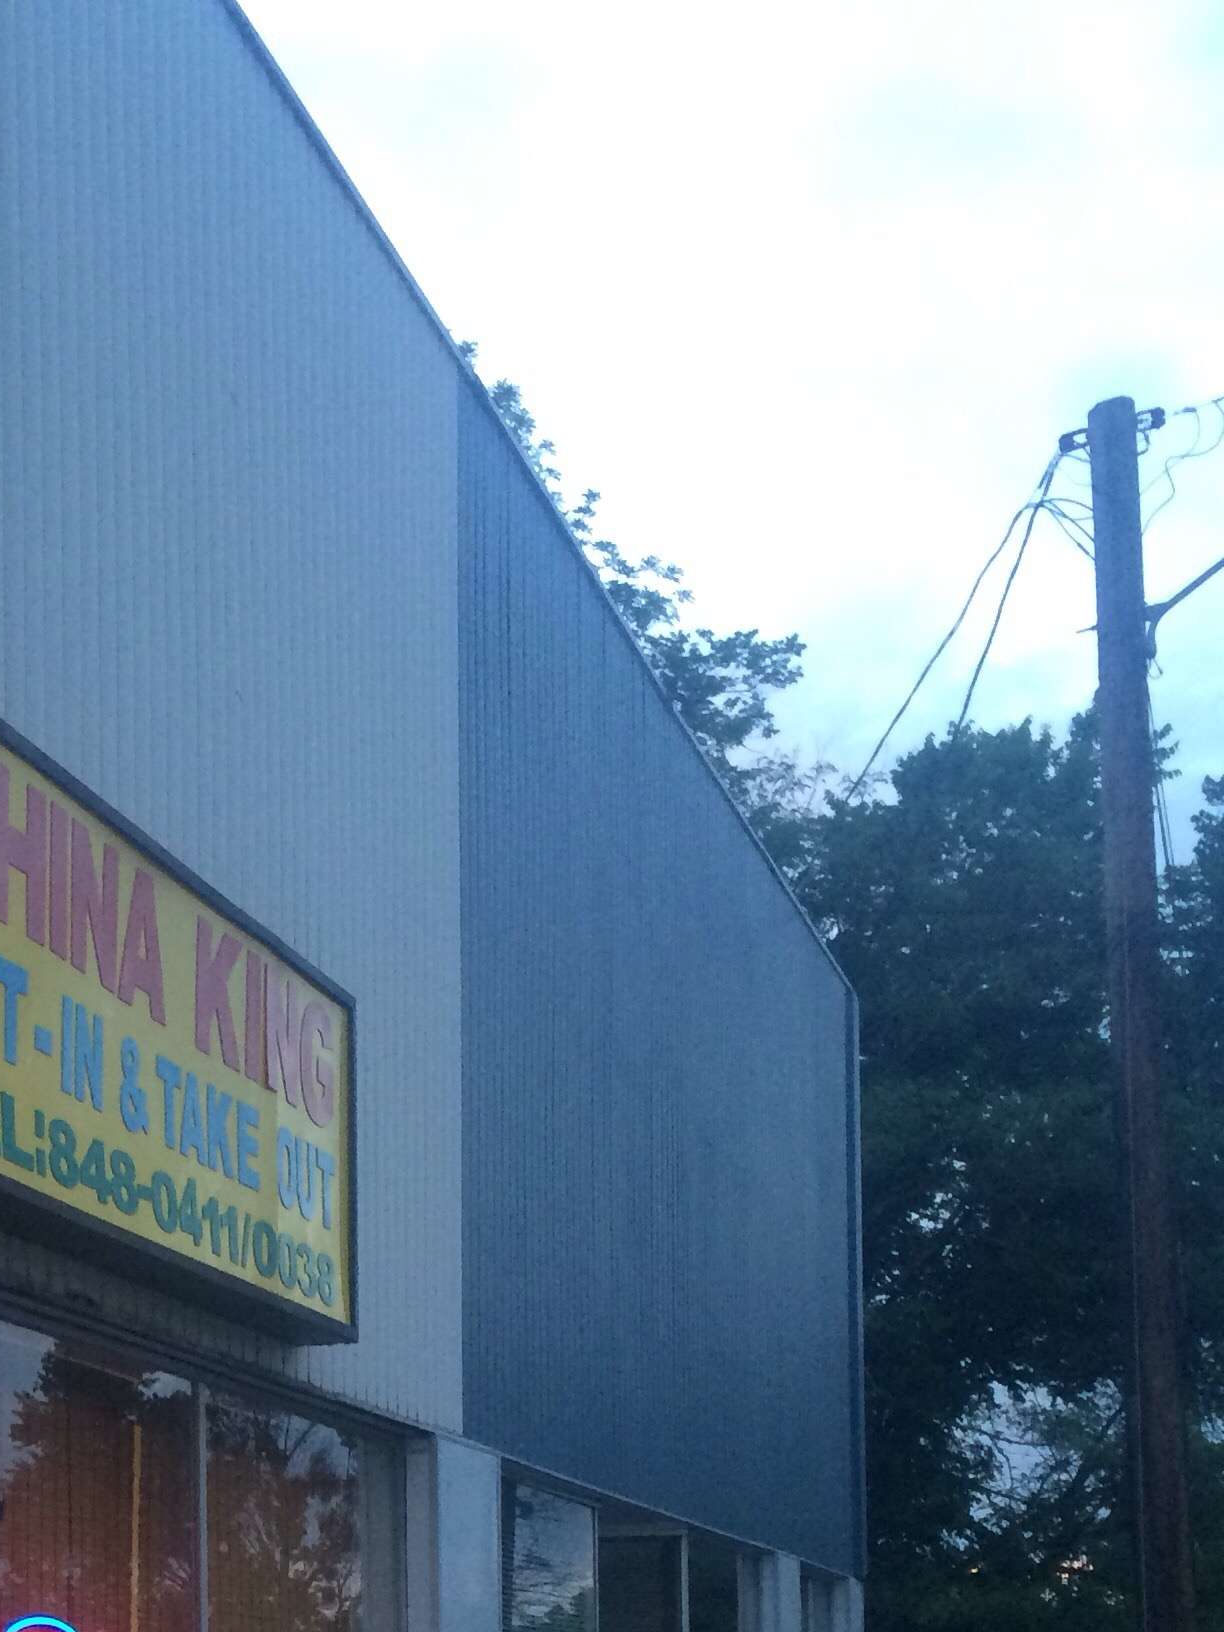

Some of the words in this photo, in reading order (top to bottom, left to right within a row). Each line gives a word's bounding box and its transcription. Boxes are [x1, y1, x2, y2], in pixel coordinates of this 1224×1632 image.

[194, 914, 335, 1129] KING
[120, 1036, 150, 1136] &
[156, 1054, 261, 1192] TAKE
[277, 1126, 336, 1230] OUT
